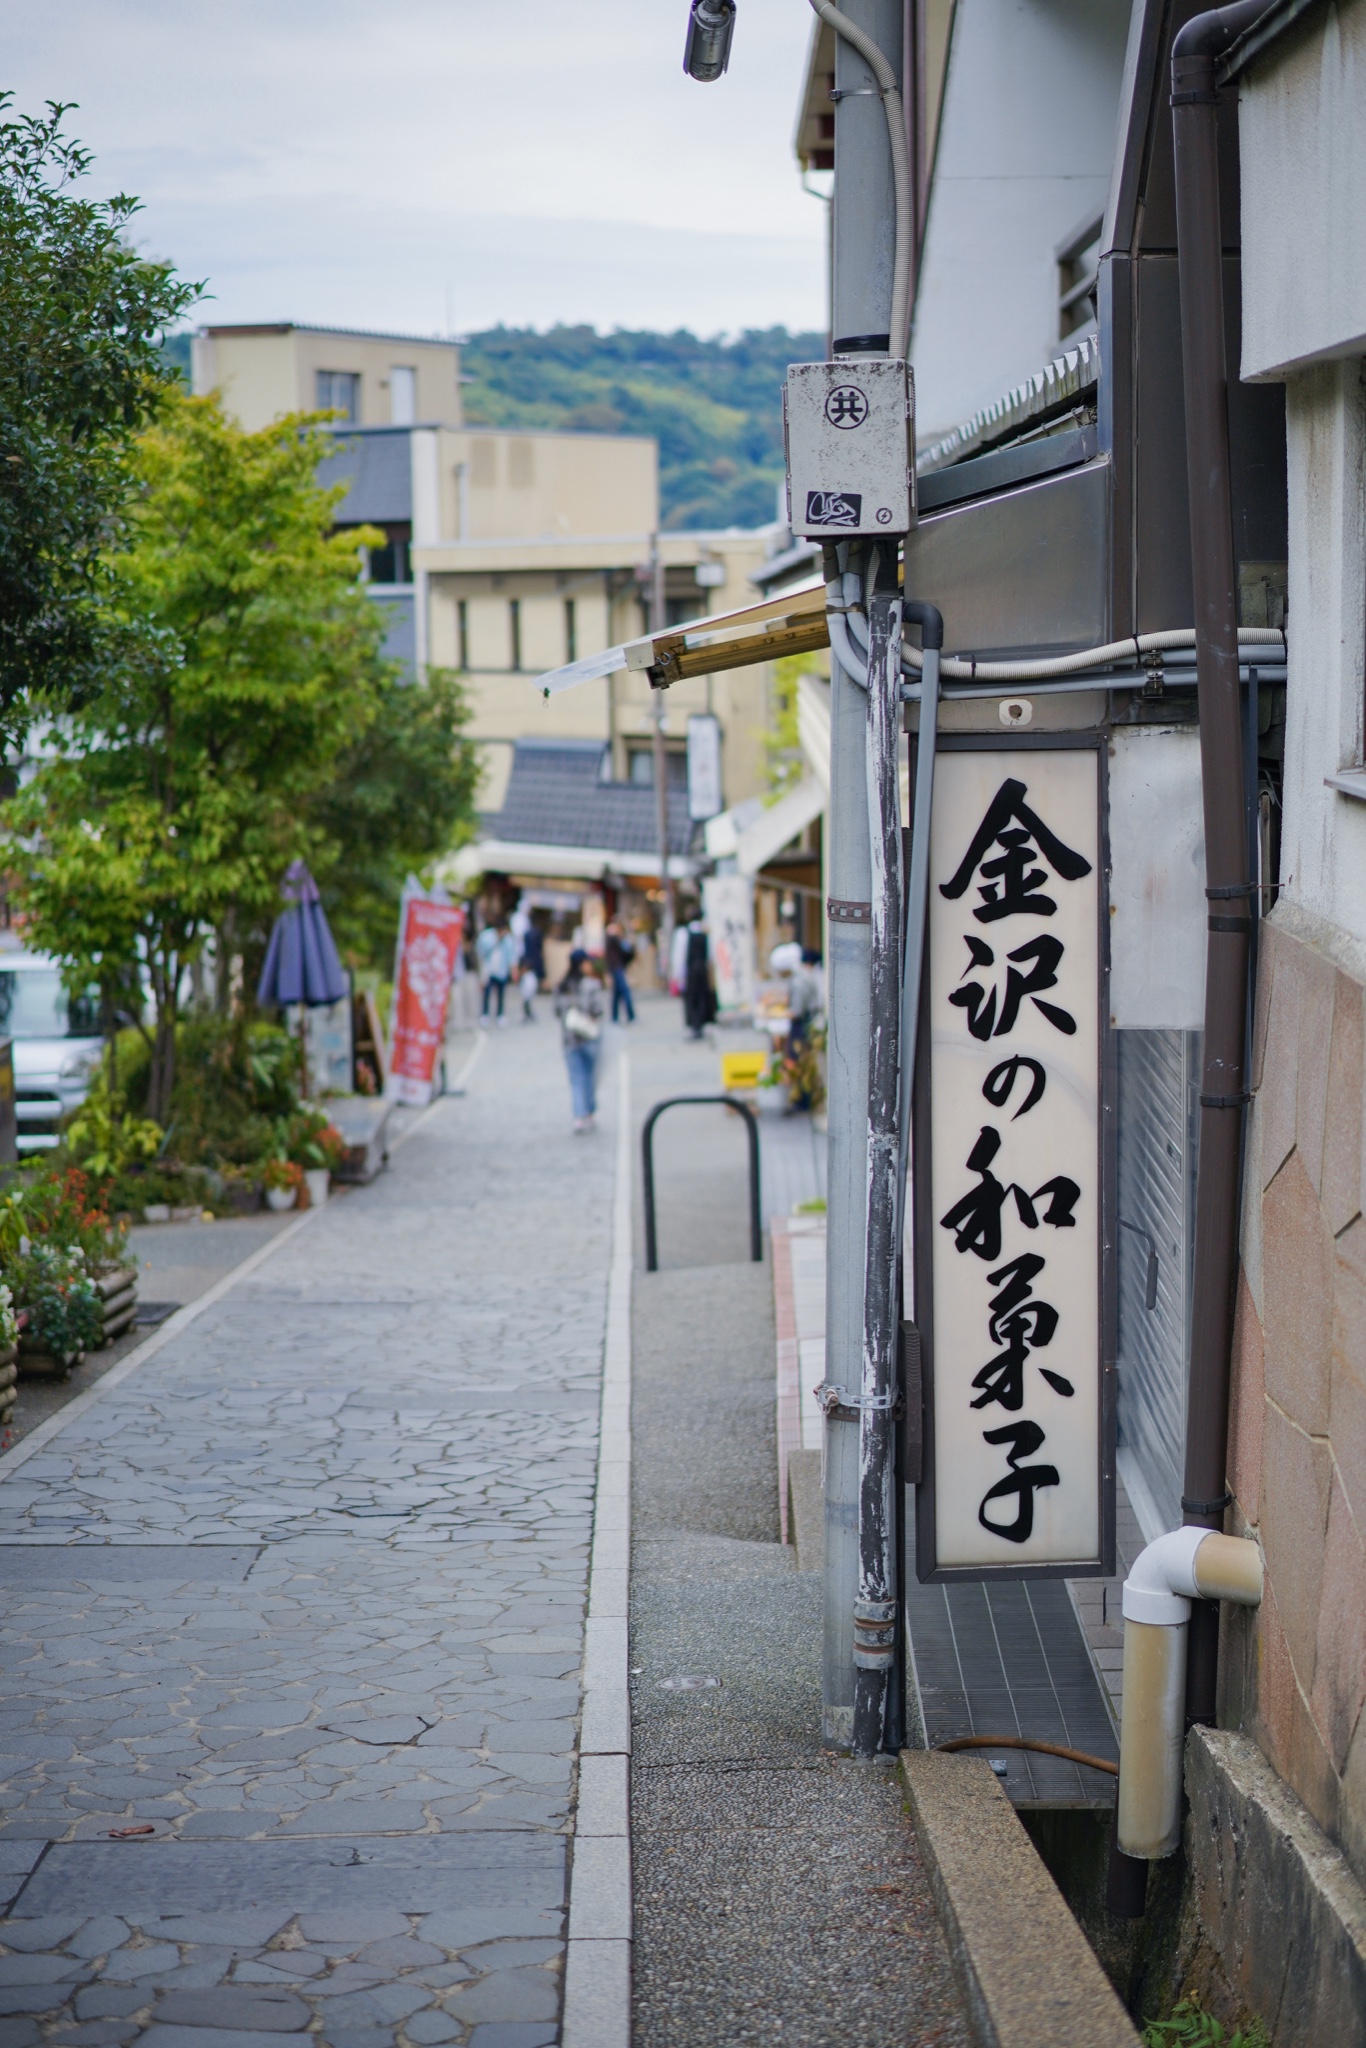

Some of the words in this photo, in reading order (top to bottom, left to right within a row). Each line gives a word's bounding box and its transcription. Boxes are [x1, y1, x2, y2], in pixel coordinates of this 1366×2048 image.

[830, 390, 864, 424] 共
[938, 777, 1092, 1544] 金沢の和菓子
